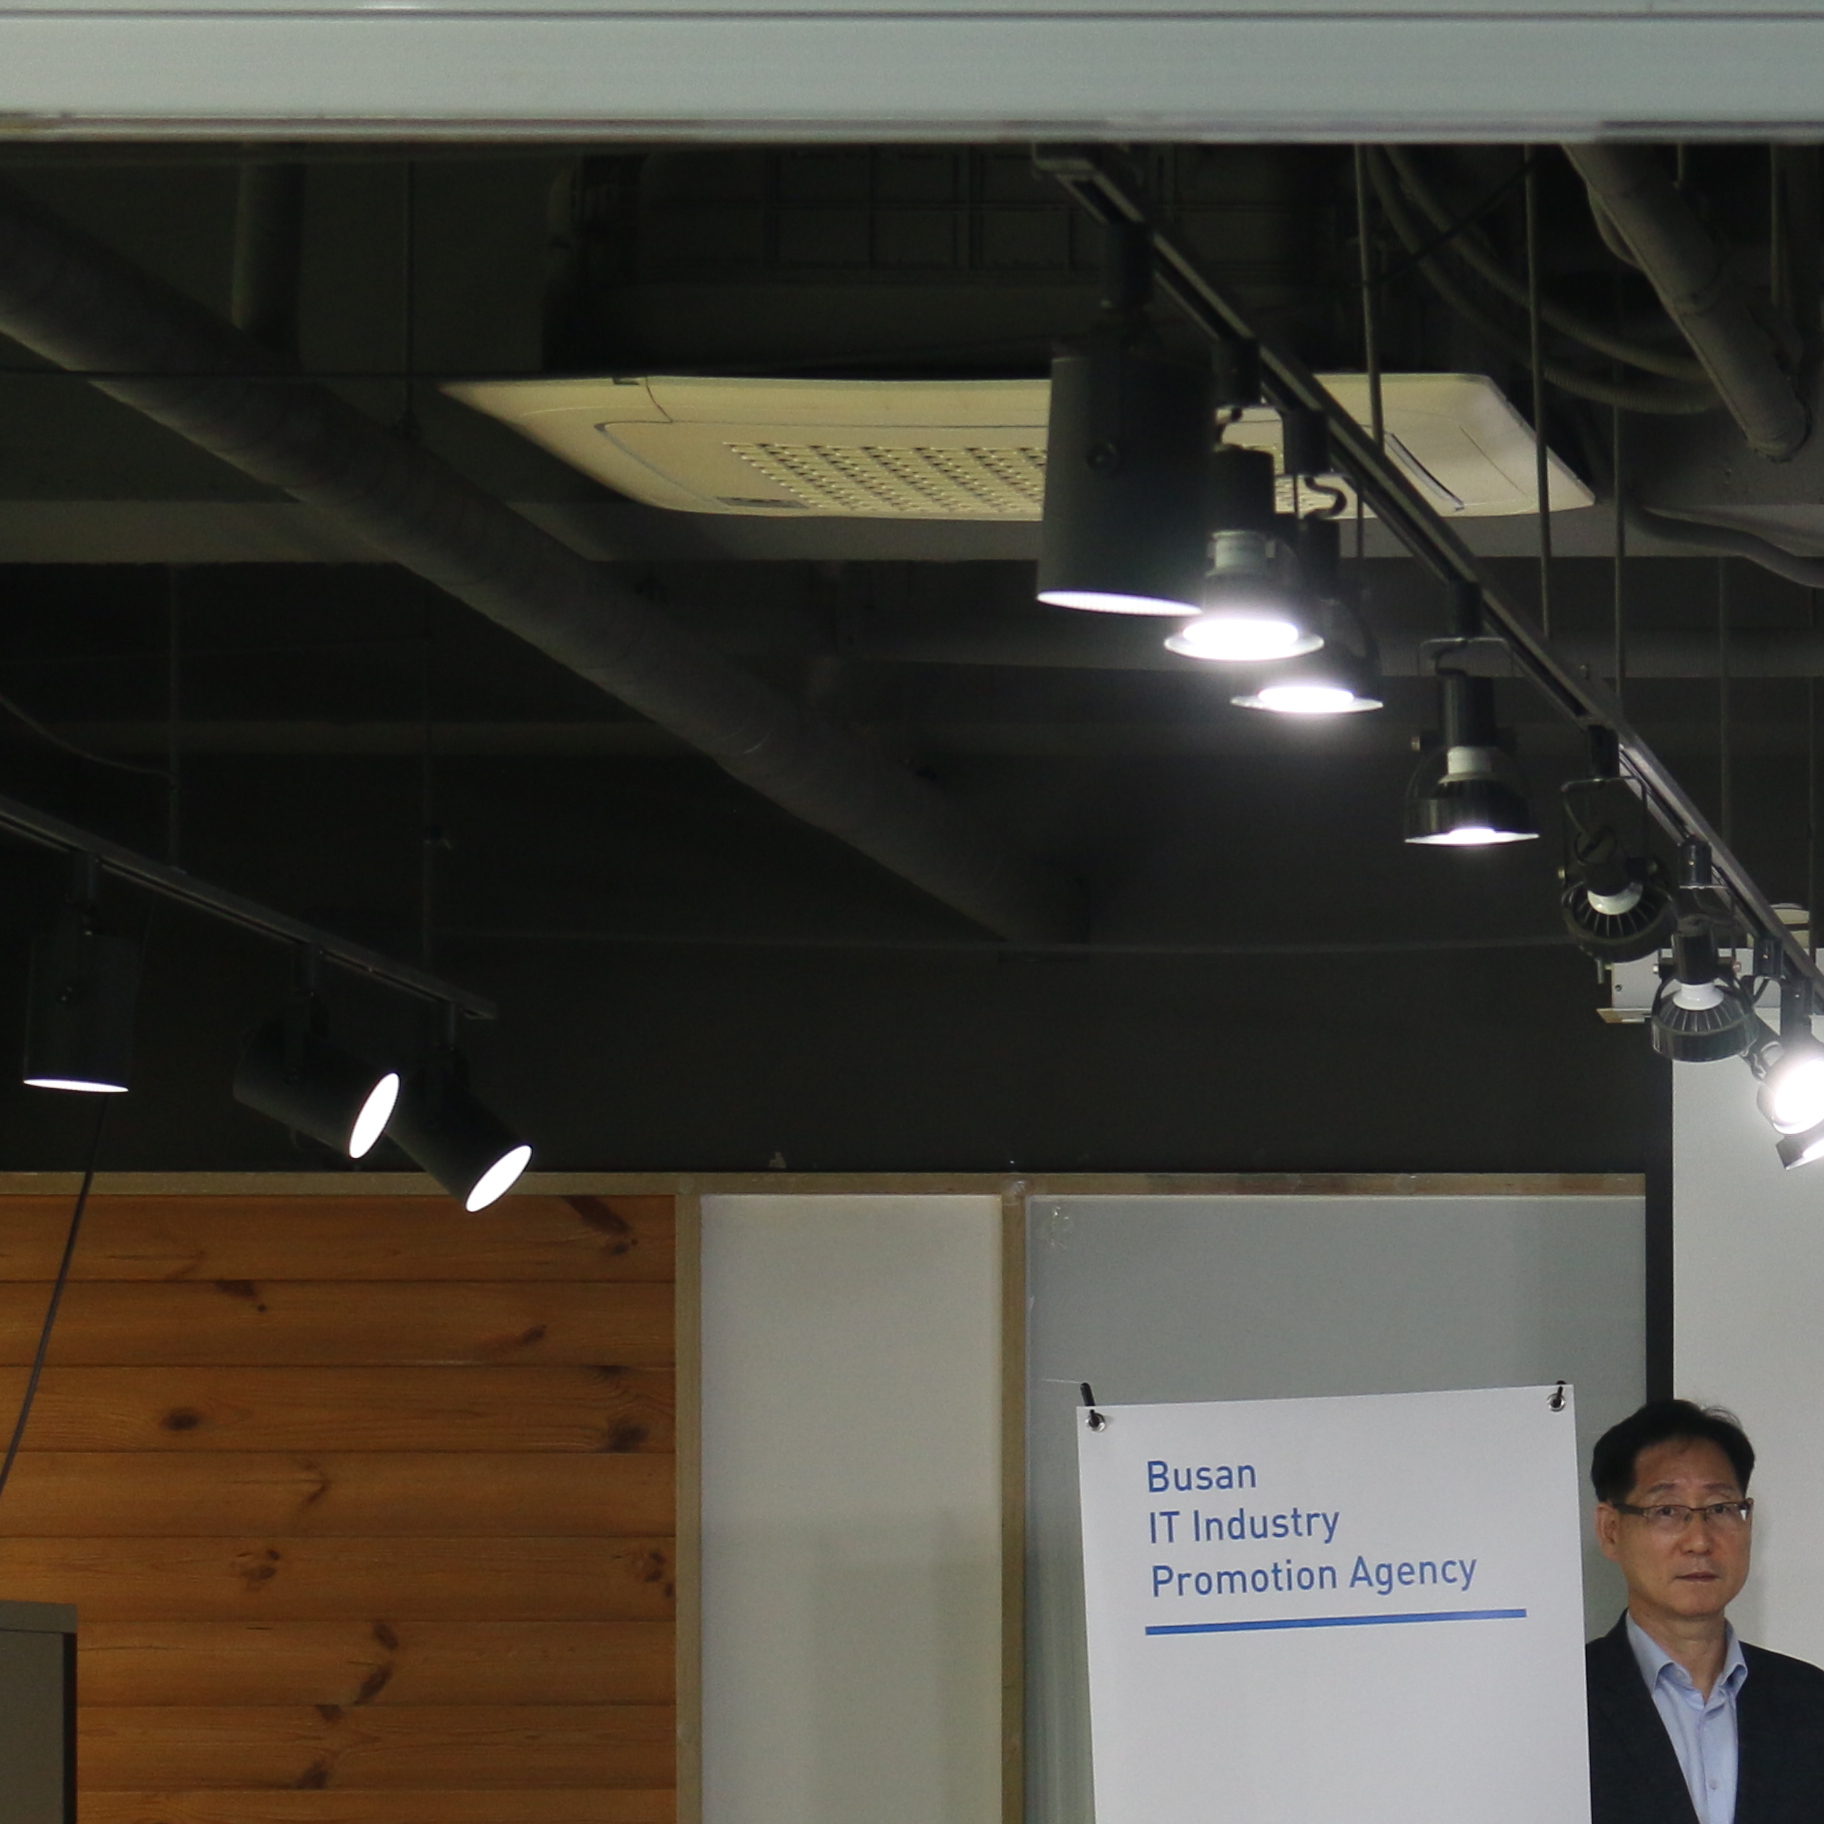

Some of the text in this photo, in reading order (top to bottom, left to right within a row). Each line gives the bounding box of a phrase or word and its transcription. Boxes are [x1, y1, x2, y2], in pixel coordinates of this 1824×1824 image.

[1148, 1460, 1256, 1492] Busan
[1150, 1508, 1339, 1543] IT Industry
[1152, 1556, 1476, 1597] Promotion Agency
